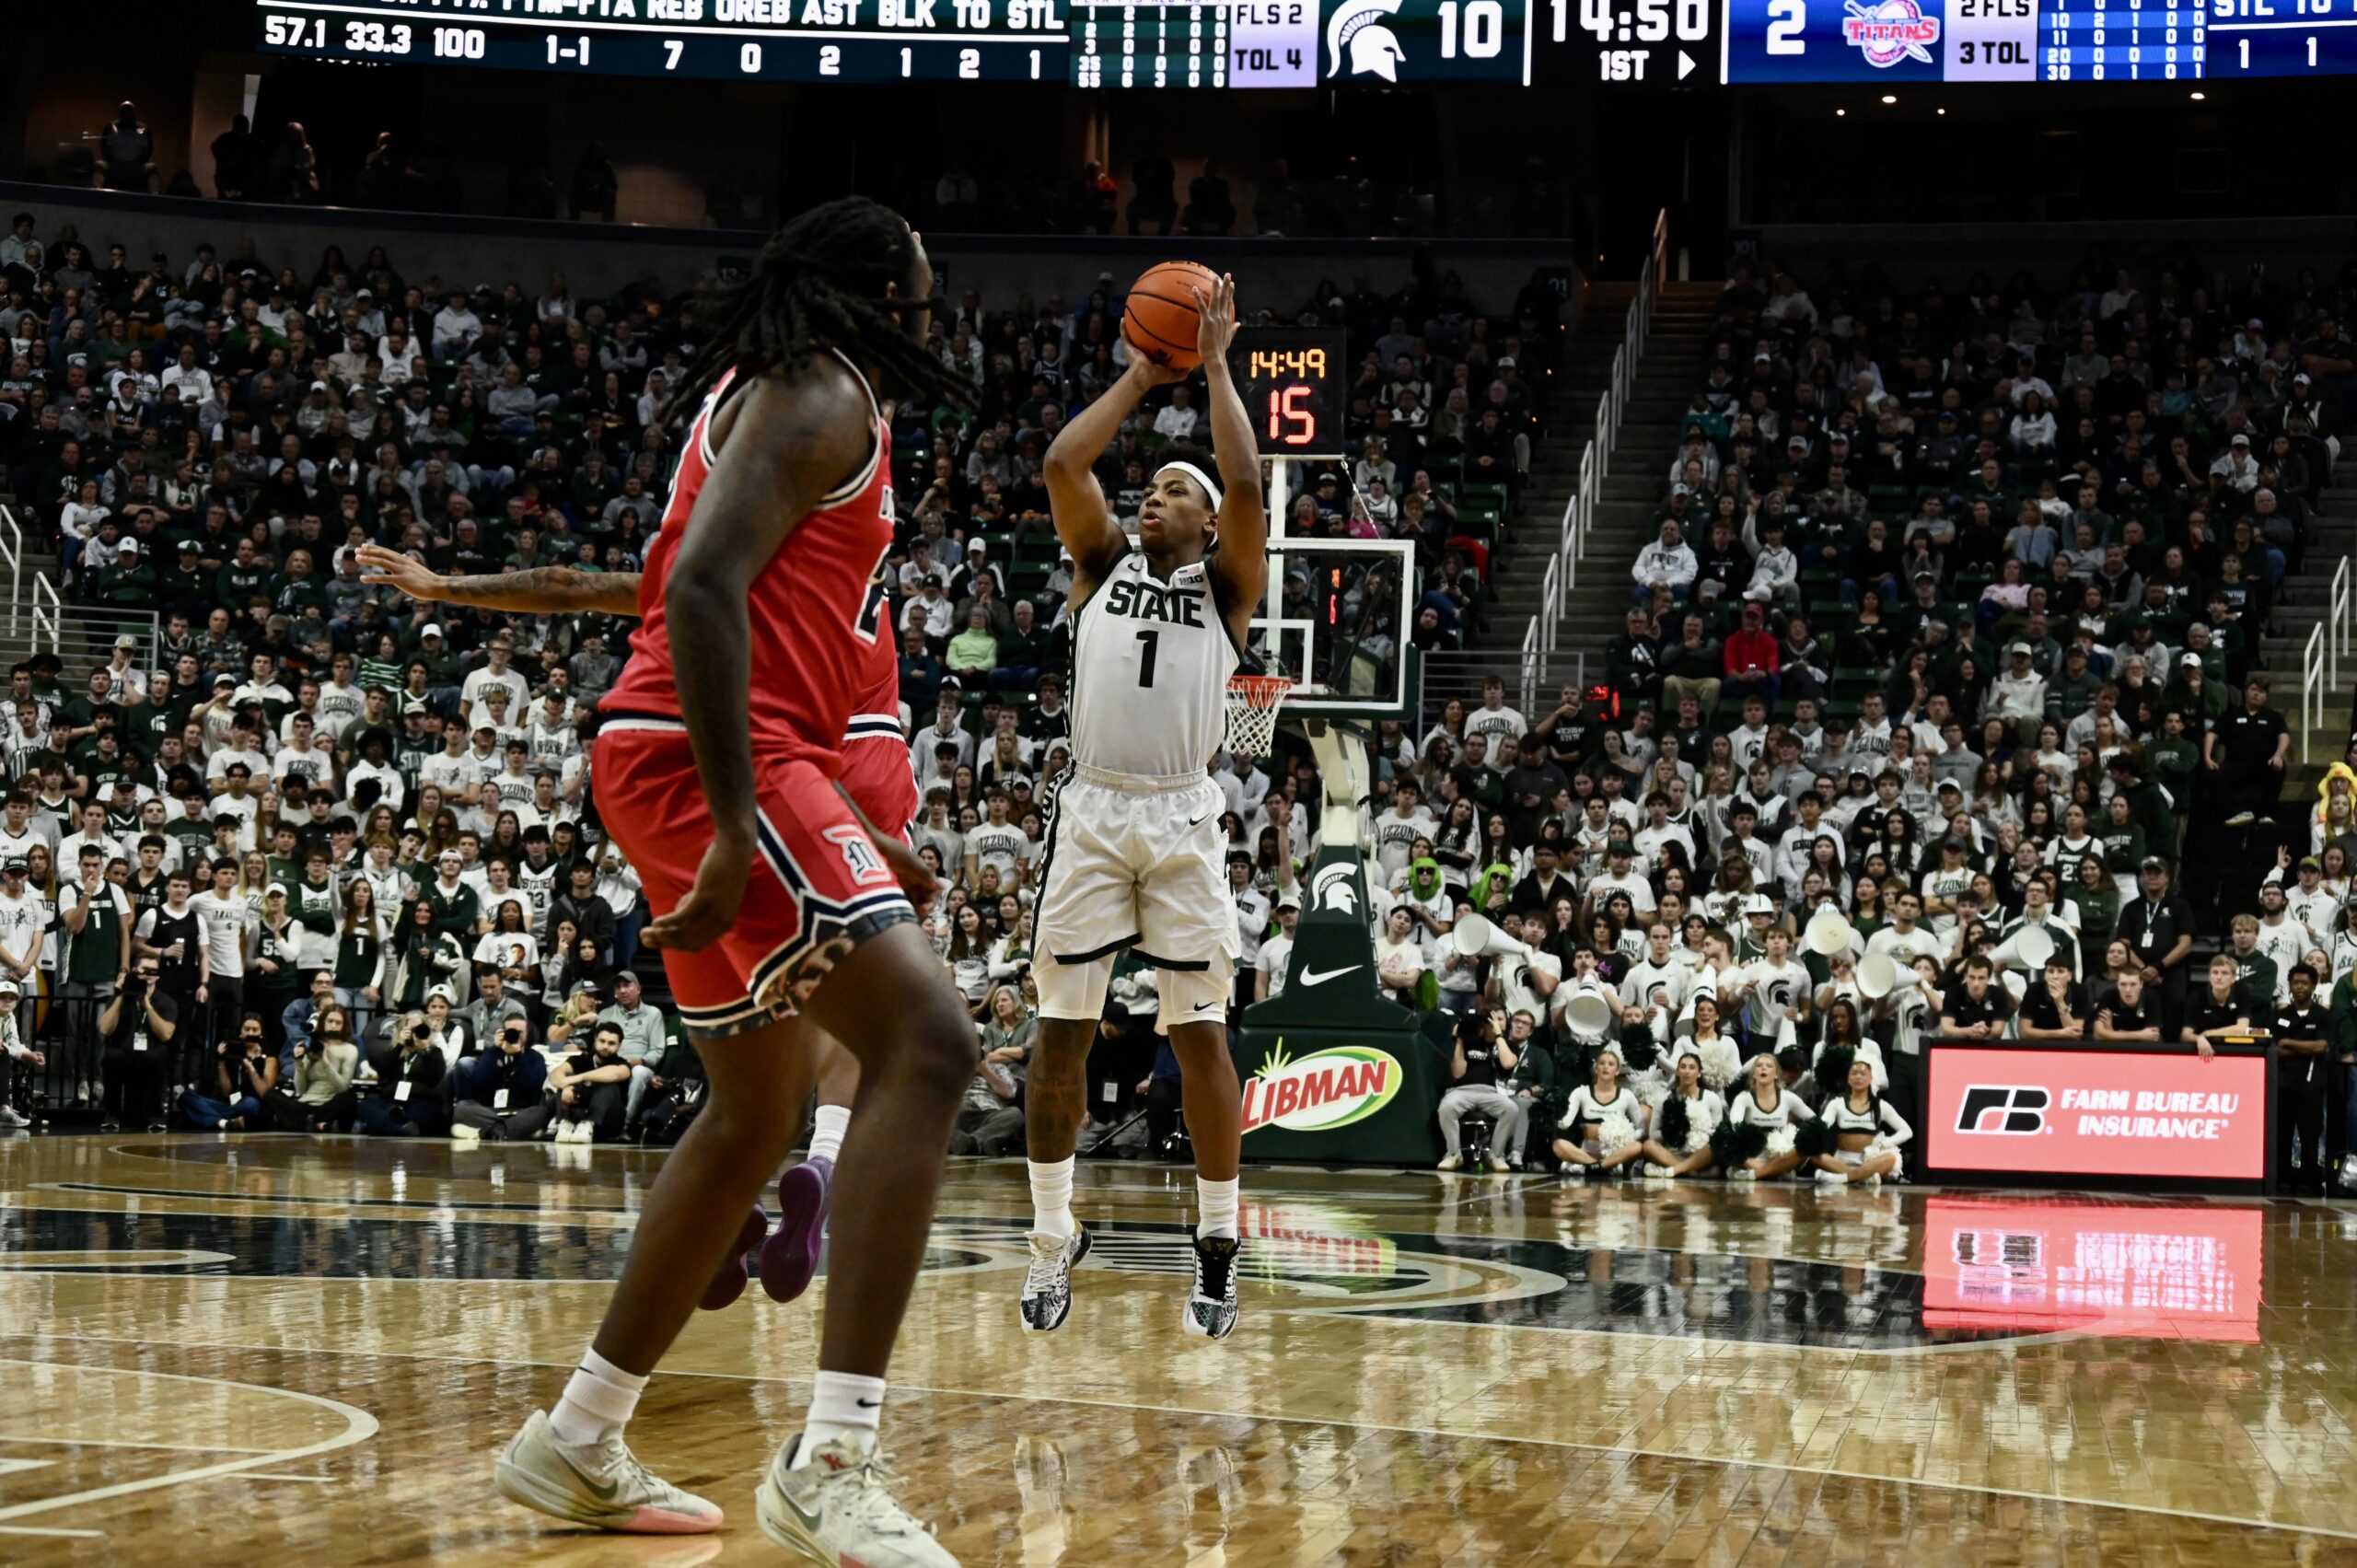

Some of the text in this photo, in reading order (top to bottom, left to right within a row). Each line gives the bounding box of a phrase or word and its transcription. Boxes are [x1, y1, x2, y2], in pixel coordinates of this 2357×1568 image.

[647, 0, 702, 20] REB
[715, 0, 790, 24] OREB
[801, 0, 862, 26] AST
[877, 0, 935, 28] BLK
[953, 0, 991, 29] TO
[1007, 0, 1064, 29] STL
[1088, 5, 1226, 21] 1 2 1 2 0
[1237, 4, 1303, 25] FLS 2
[1960, 0, 2030, 17] 2 FLS
[1085, 21, 1226, 39] 2 2 1 0 0
[1437, 1, 1503, 58] 10
[1550, 0, 1709, 42] 14:50
[1767, 0, 1805, 55] 2
[2051, 10, 2204, 29] 10 2 1 0 0
[265, 15, 1040, 79] 57.1 33.3 100 1-1 7 0 2 1 2 1
[1085, 39, 1225, 54] 3 0 1 0 0
[2053, 28, 2204, 46] 11 0 1 0 0
[1235, 49, 1302, 71] TOL 4
[1959, 41, 2030, 64] 3 TOL
[2047, 45, 2204, 64] 20 0 0 0 0
[2238, 37, 2317, 69] 1 1
[1122, 55, 1134, 72] 0
[1155, 55, 1167, 72] 0
[1189, 55, 1201, 72] 0
[1213, 55, 1225, 72] 0
[1599, 50, 1650, 81] 1ST
[2047, 63, 2201, 81] 30 0 1 0 1
[1155, 71, 1166, 88] 3
[1188, 71, 1200, 88] 0
[1213, 71, 1225, 88] 0
[1250, 348, 1326, 379] 14:49
[1270, 386, 1315, 444] 15
[1105, 579, 1207, 629] STATE
[1136, 630, 1159, 689] 1
[1478, 717, 1514, 733] IZZONE
[500, 784, 533, 800] ZZONE
[980, 833, 1018, 851] IZZONE
[92, 910, 101, 929] 1
[355, 937, 365, 957] 1
[1240, 1060, 1388, 1132] LIBMAN
[2061, 1088, 2239, 1114] FARM BUREAU
